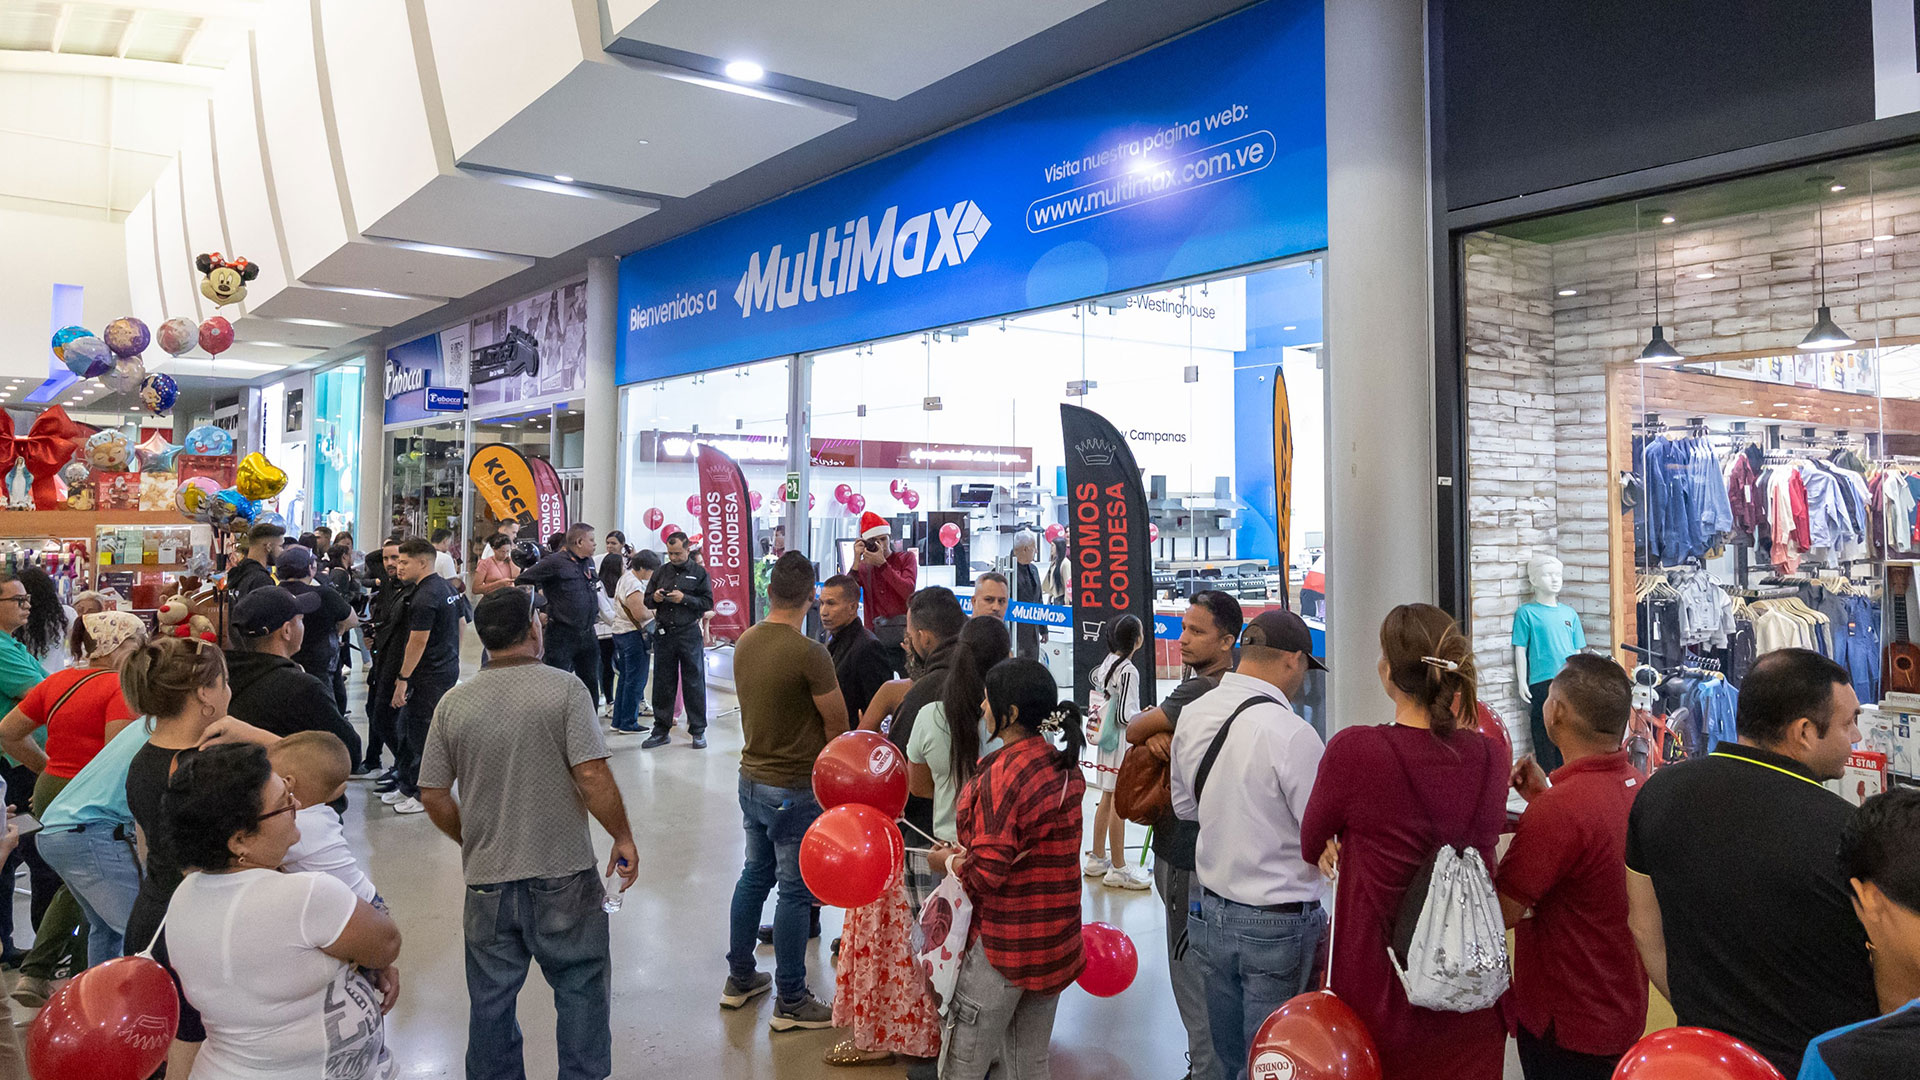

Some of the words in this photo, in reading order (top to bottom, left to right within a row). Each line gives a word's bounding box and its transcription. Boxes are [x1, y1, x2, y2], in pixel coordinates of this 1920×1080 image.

[1044, 159, 1080, 184] Visita
[1083, 140, 1139, 171] nuestra
[1143, 119, 1200, 157] página
[1204, 103, 1249, 131] web:
[1034, 141, 1264, 226] www.multimax.com.ve
[742, 200, 968, 318] MultiMax
[630, 291, 704, 332] Bienvenidos
[706, 289, 717, 312] a
[383, 359, 422, 400] Fabocca
[1129, 429, 1187, 445] Campanas
[540, 493, 551, 547] ROMOS
[551, 493, 561, 534] NDESA
[706, 491, 723, 567] PROMOS
[725, 491, 740, 568] CONDESA
[1075, 482, 1102, 608] PROMOS
[1105, 482, 1130, 610] CONDESA
[1014, 605, 1062, 624] MultiMax
[1855, 758, 1877, 770] STAR
